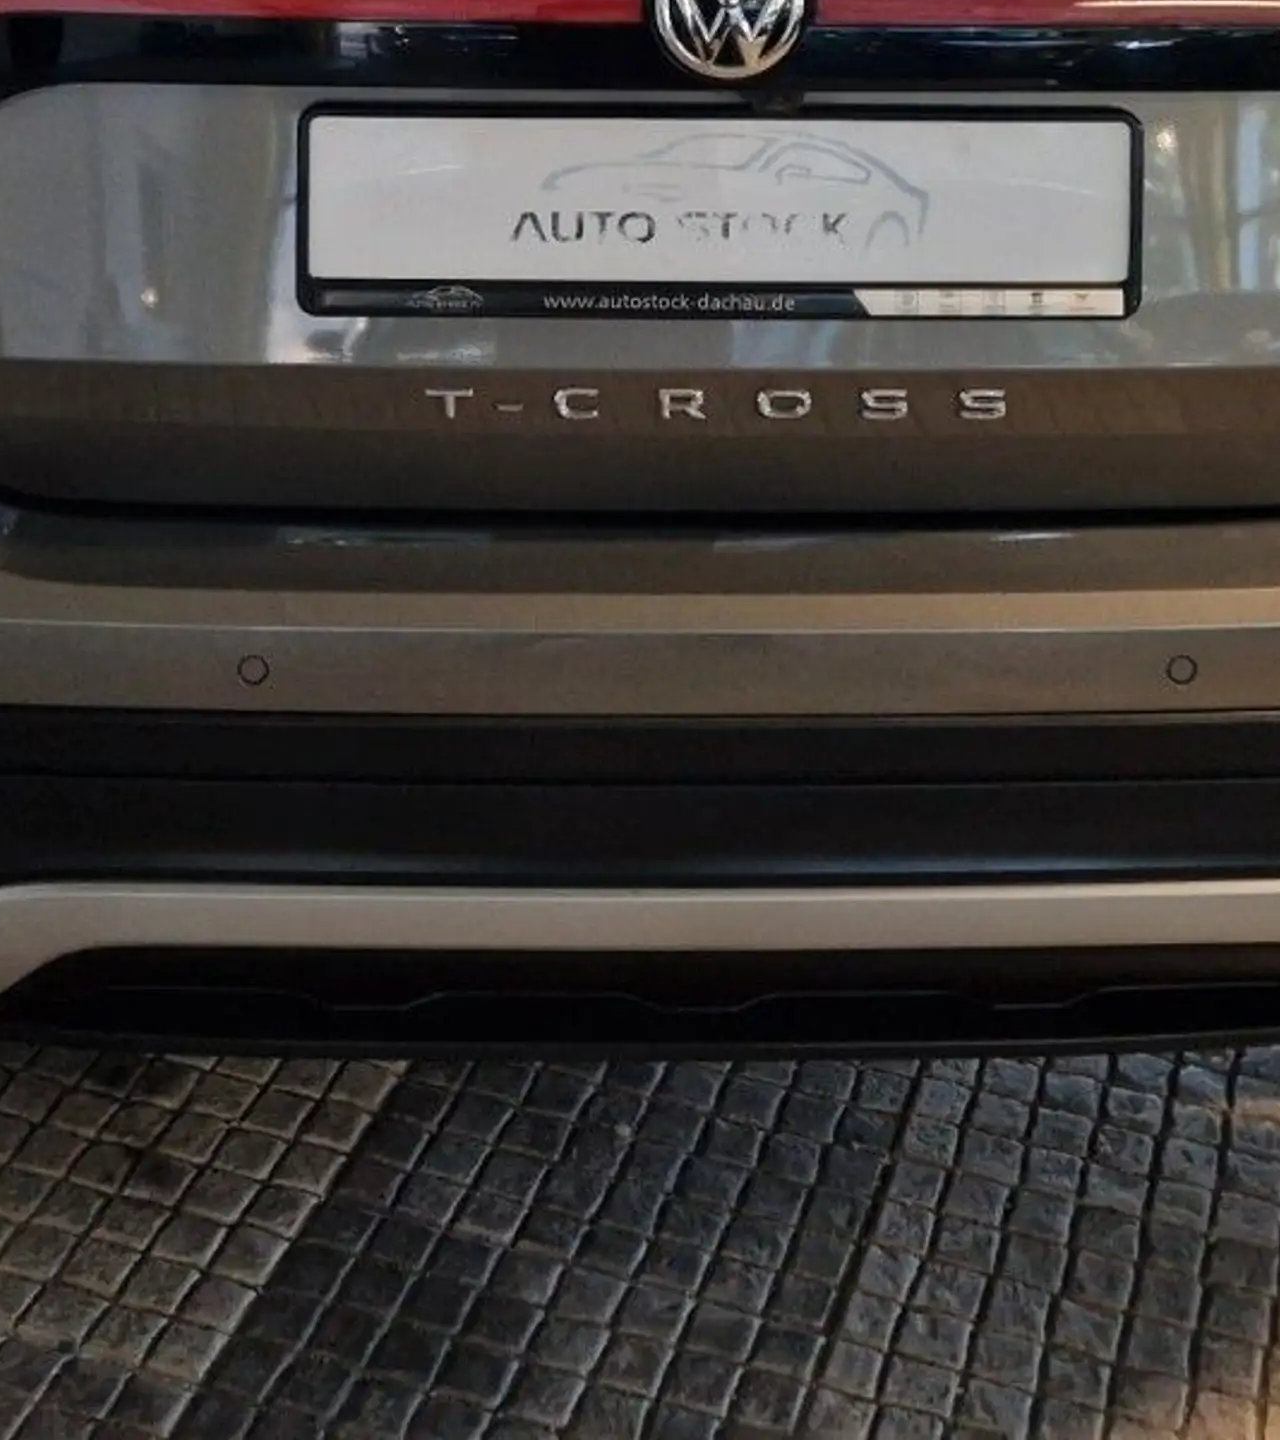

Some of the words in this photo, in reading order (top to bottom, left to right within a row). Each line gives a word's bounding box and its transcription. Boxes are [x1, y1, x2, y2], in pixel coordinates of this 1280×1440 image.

[509, 210, 657, 244] AUTO
[543, 291, 797, 313] www.autostock-dachau.de
[424, 387, 1008, 421] T-CROSS
